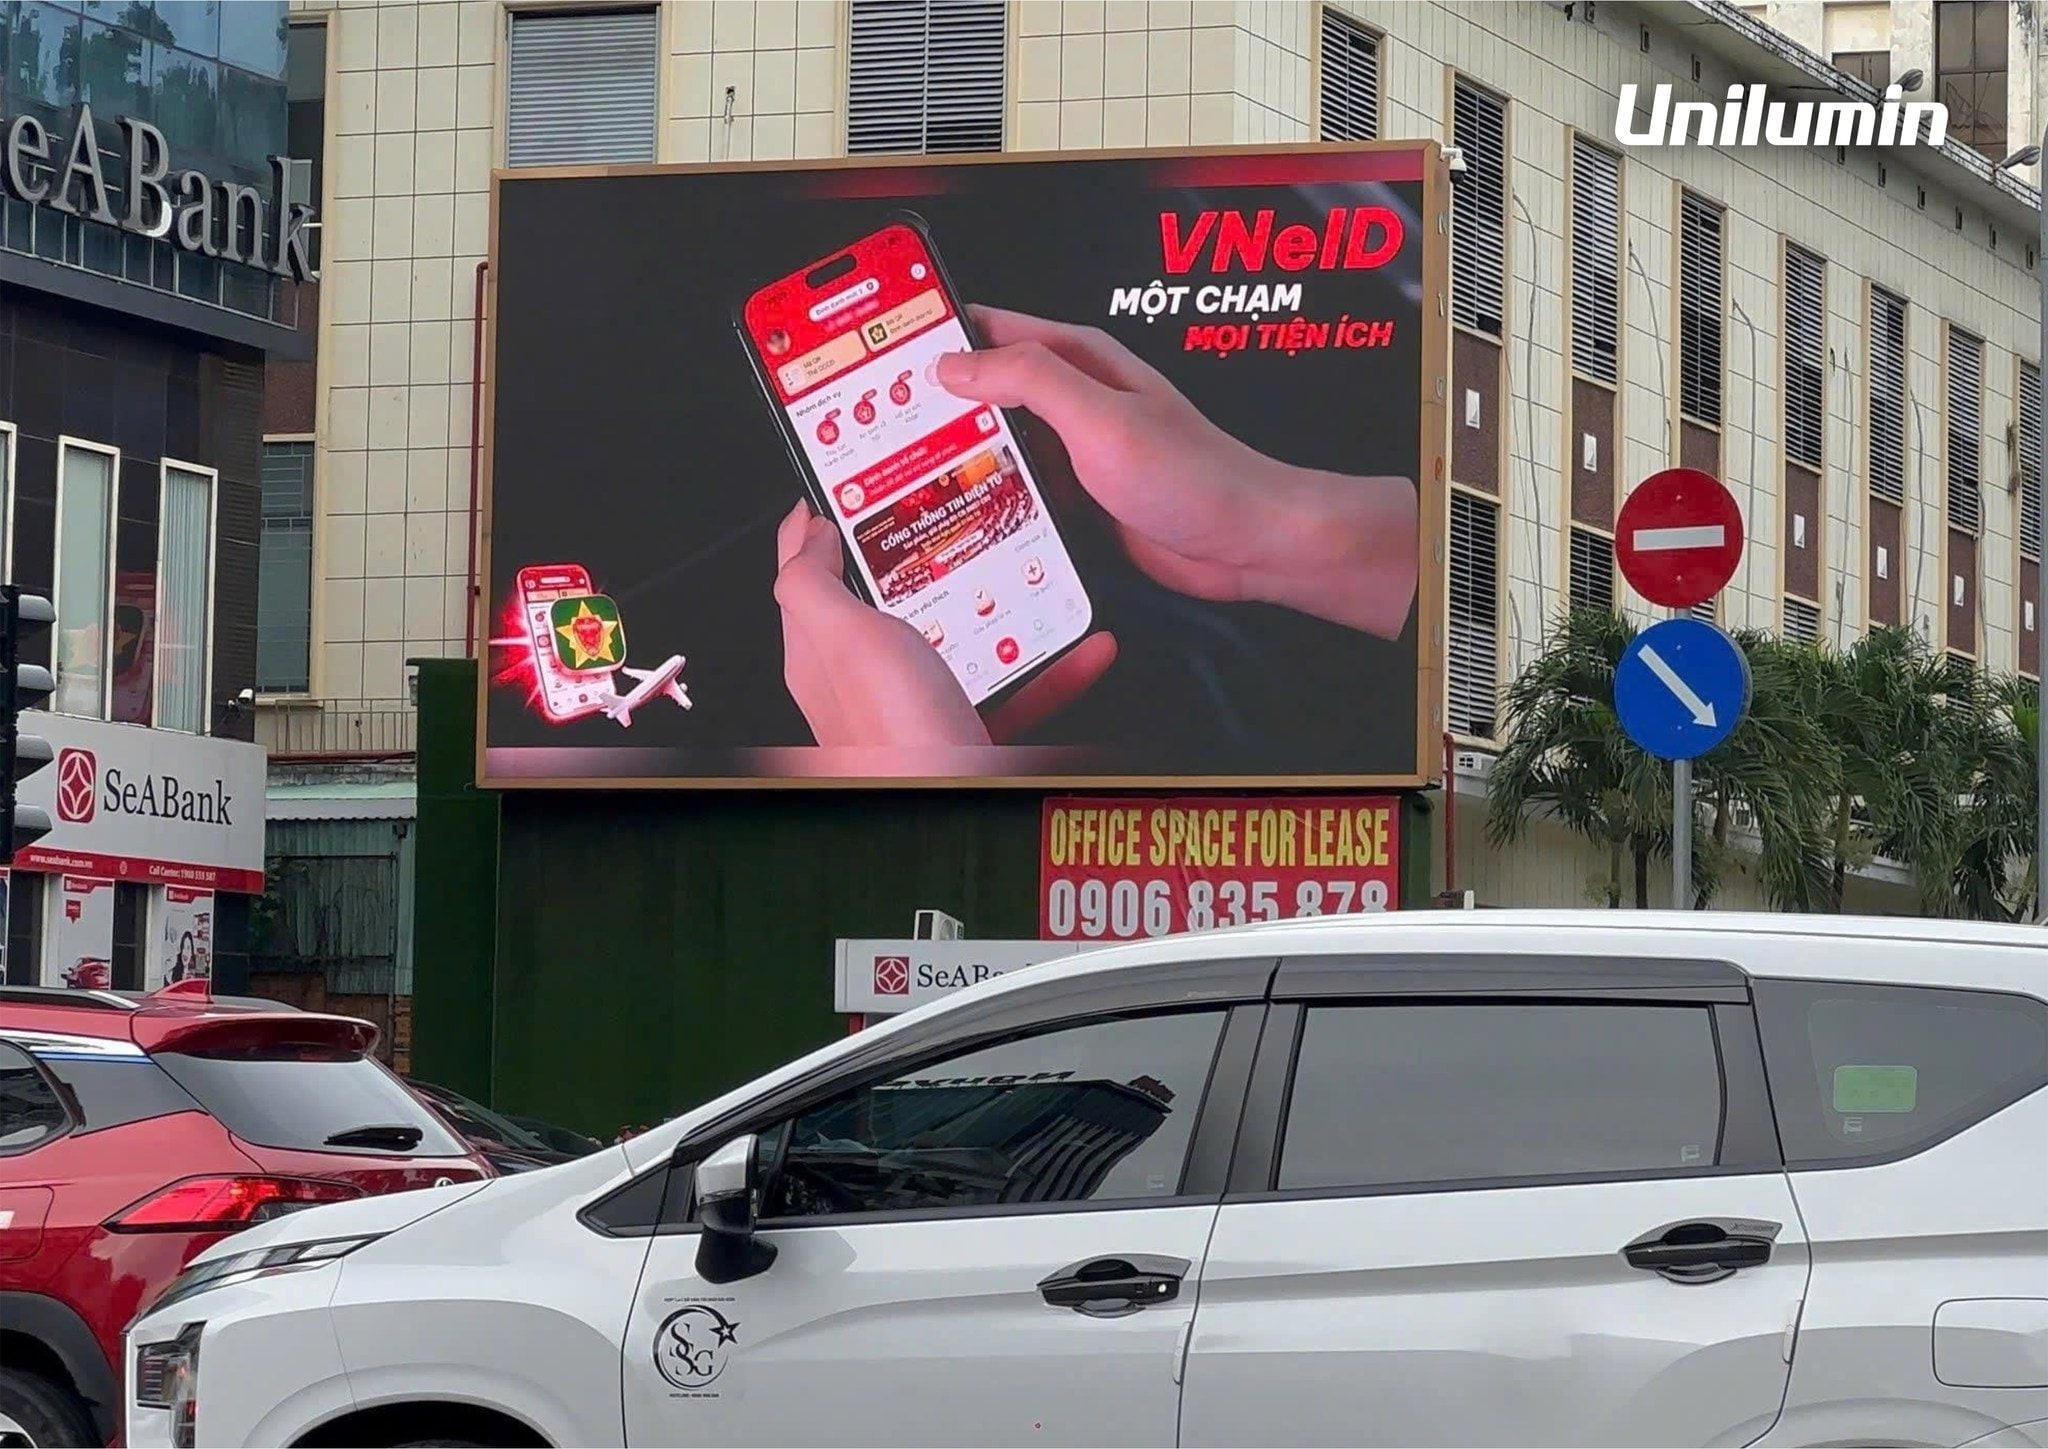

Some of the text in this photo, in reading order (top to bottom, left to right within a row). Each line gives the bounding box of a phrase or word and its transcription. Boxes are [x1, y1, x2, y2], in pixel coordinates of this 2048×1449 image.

[2, 102, 318, 283] eABank
[1159, 206, 1406, 274] VNeID
[1109, 280, 1302, 323] MỘT CHẠM
[1183, 314, 1394, 359] MỌI TIỆN ÍCH
[103, 768, 232, 825] SeABank
[1049, 808, 1390, 867] OFFICE SPACE FOR LEASE
[1048, 880, 1389, 938] 0906 835 878
[917, 963, 1033, 988] SeAB
